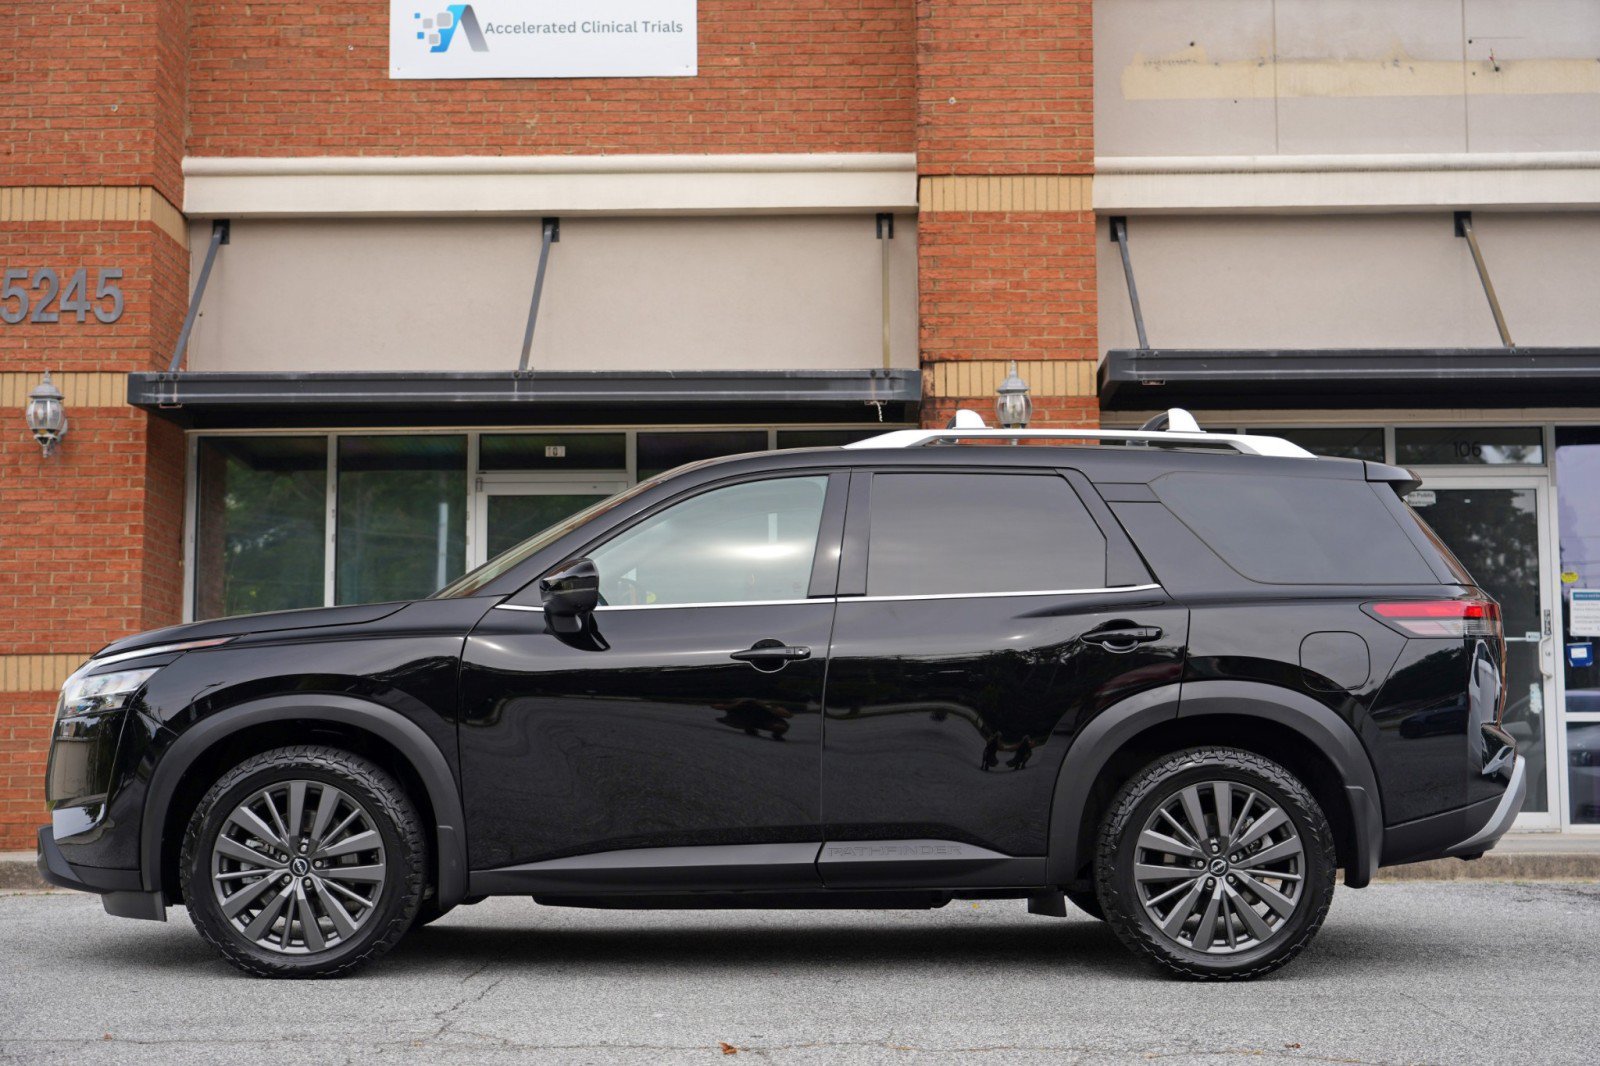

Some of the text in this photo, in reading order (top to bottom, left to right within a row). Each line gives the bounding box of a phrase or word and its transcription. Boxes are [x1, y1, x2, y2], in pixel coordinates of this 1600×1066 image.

[485, 20, 683, 34] Accelerated Clinical Trials
[0, 267, 124, 324] 5245
[1453, 440, 1482, 457] 106
[828, 846, 962, 857] PATHFINDER
